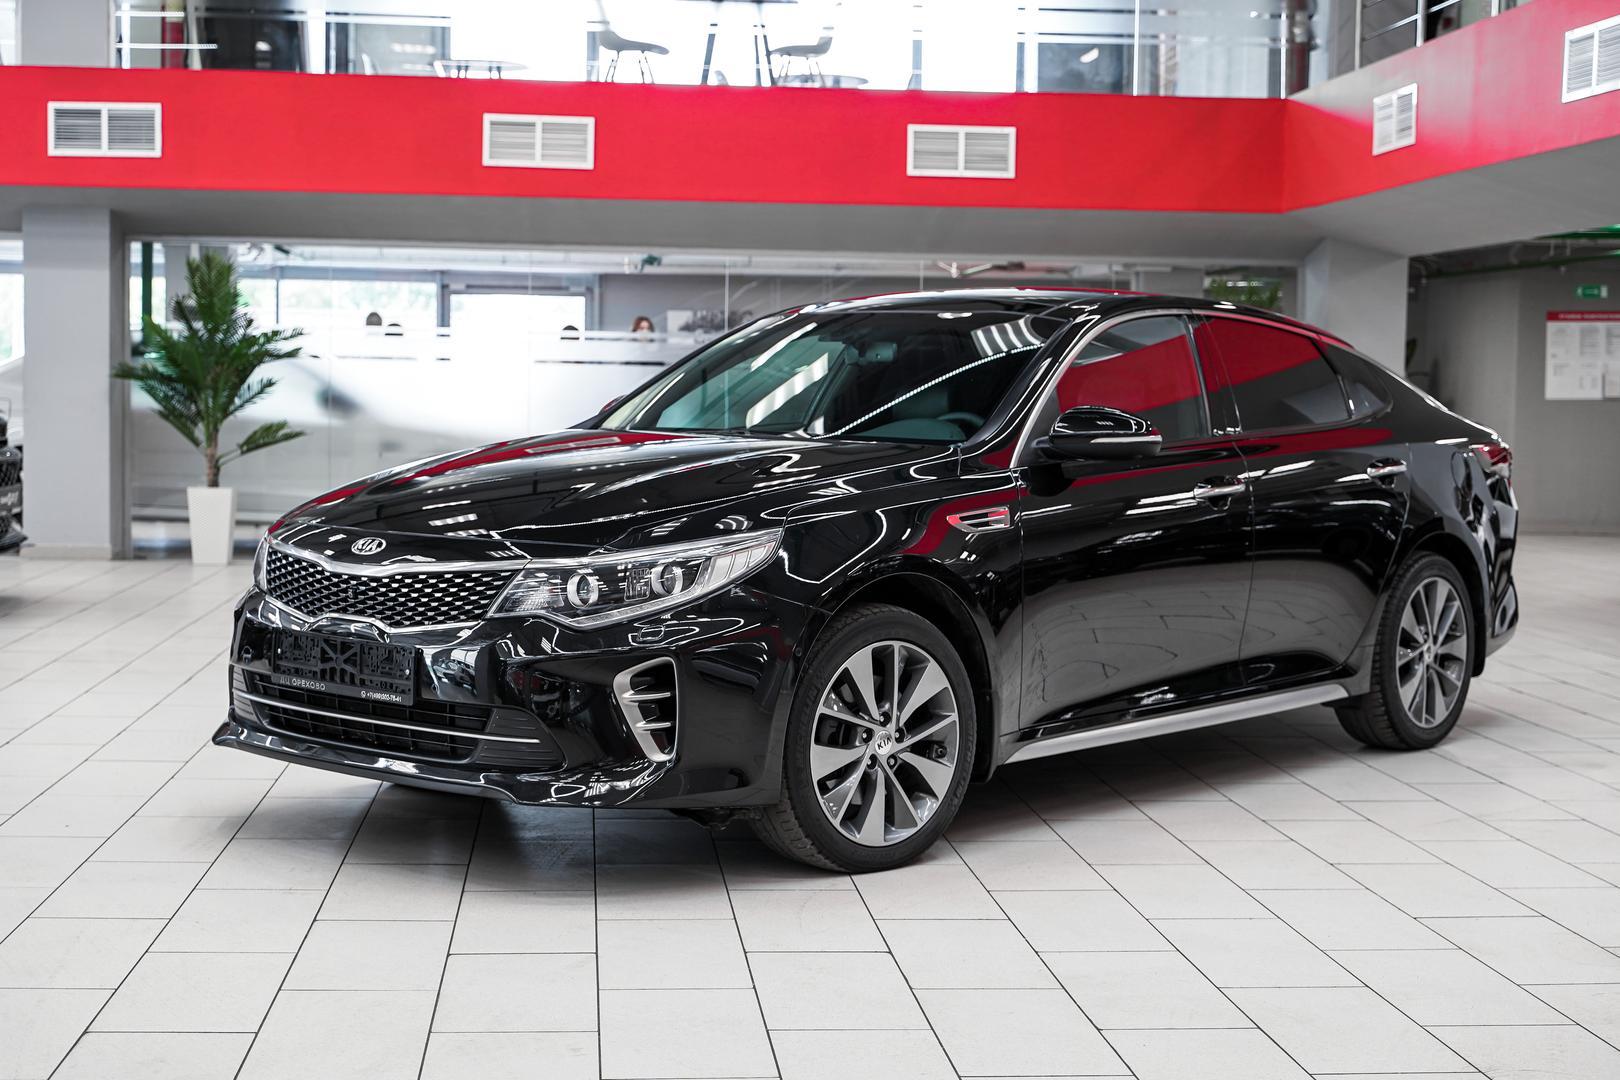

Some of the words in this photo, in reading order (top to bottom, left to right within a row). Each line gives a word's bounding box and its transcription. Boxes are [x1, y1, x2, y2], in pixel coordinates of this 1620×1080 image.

[353, 538, 382, 553] KIA
[291, 678, 326, 690] ОРЕХОВО
[876, 737, 892, 751] KIA
